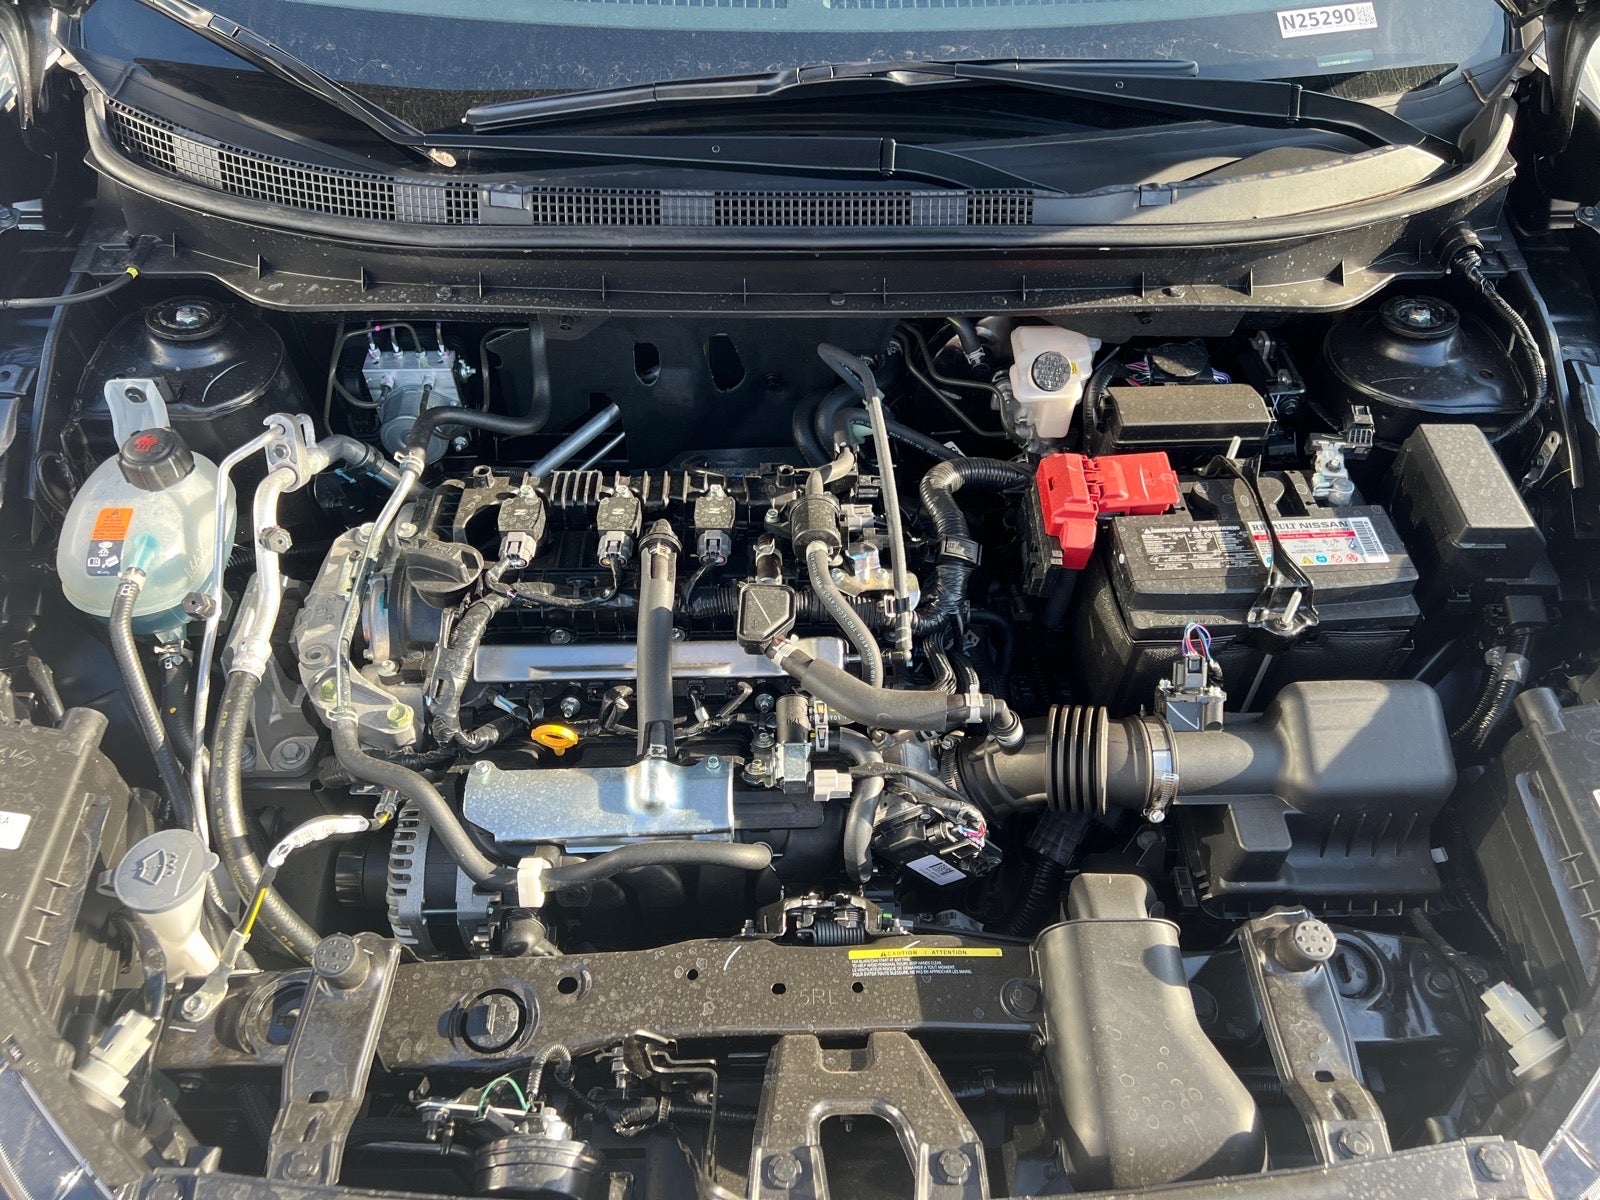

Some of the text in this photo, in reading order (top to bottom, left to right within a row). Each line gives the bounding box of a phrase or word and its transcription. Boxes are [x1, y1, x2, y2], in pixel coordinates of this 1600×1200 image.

[1282, 8, 1356, 30] N25290
[1300, 520, 1349, 529] NISSAN
[120, 584, 130, 596] B
